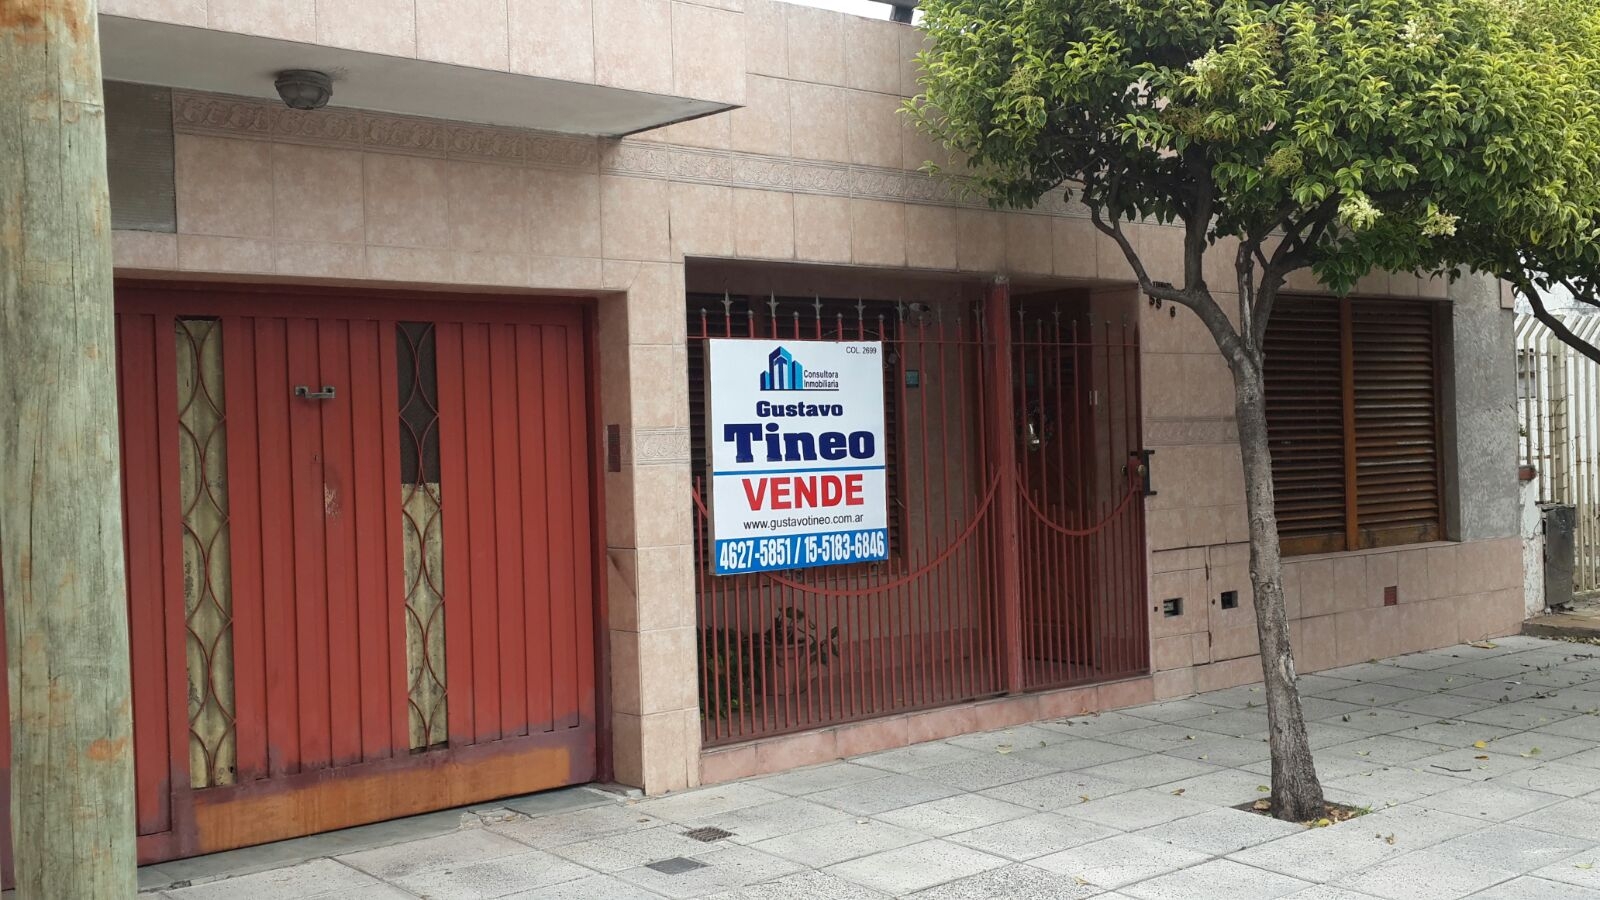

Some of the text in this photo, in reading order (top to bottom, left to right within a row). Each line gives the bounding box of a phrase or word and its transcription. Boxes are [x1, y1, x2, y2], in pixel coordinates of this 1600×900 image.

[846, 346, 877, 354] COL. 2699
[804, 370, 838, 378] Consultora
[804, 380, 838, 388] Inmobiliaria
[756, 400, 843, 418] Gustavo
[724, 422, 875, 463] Tineo
[742, 474, 864, 511] VENDE
[743, 513, 864, 530] www.gustavotineo.com.ar
[720, 537, 791, 570] 4627-5851
[804, 530, 884, 564] 15-5183-6846
